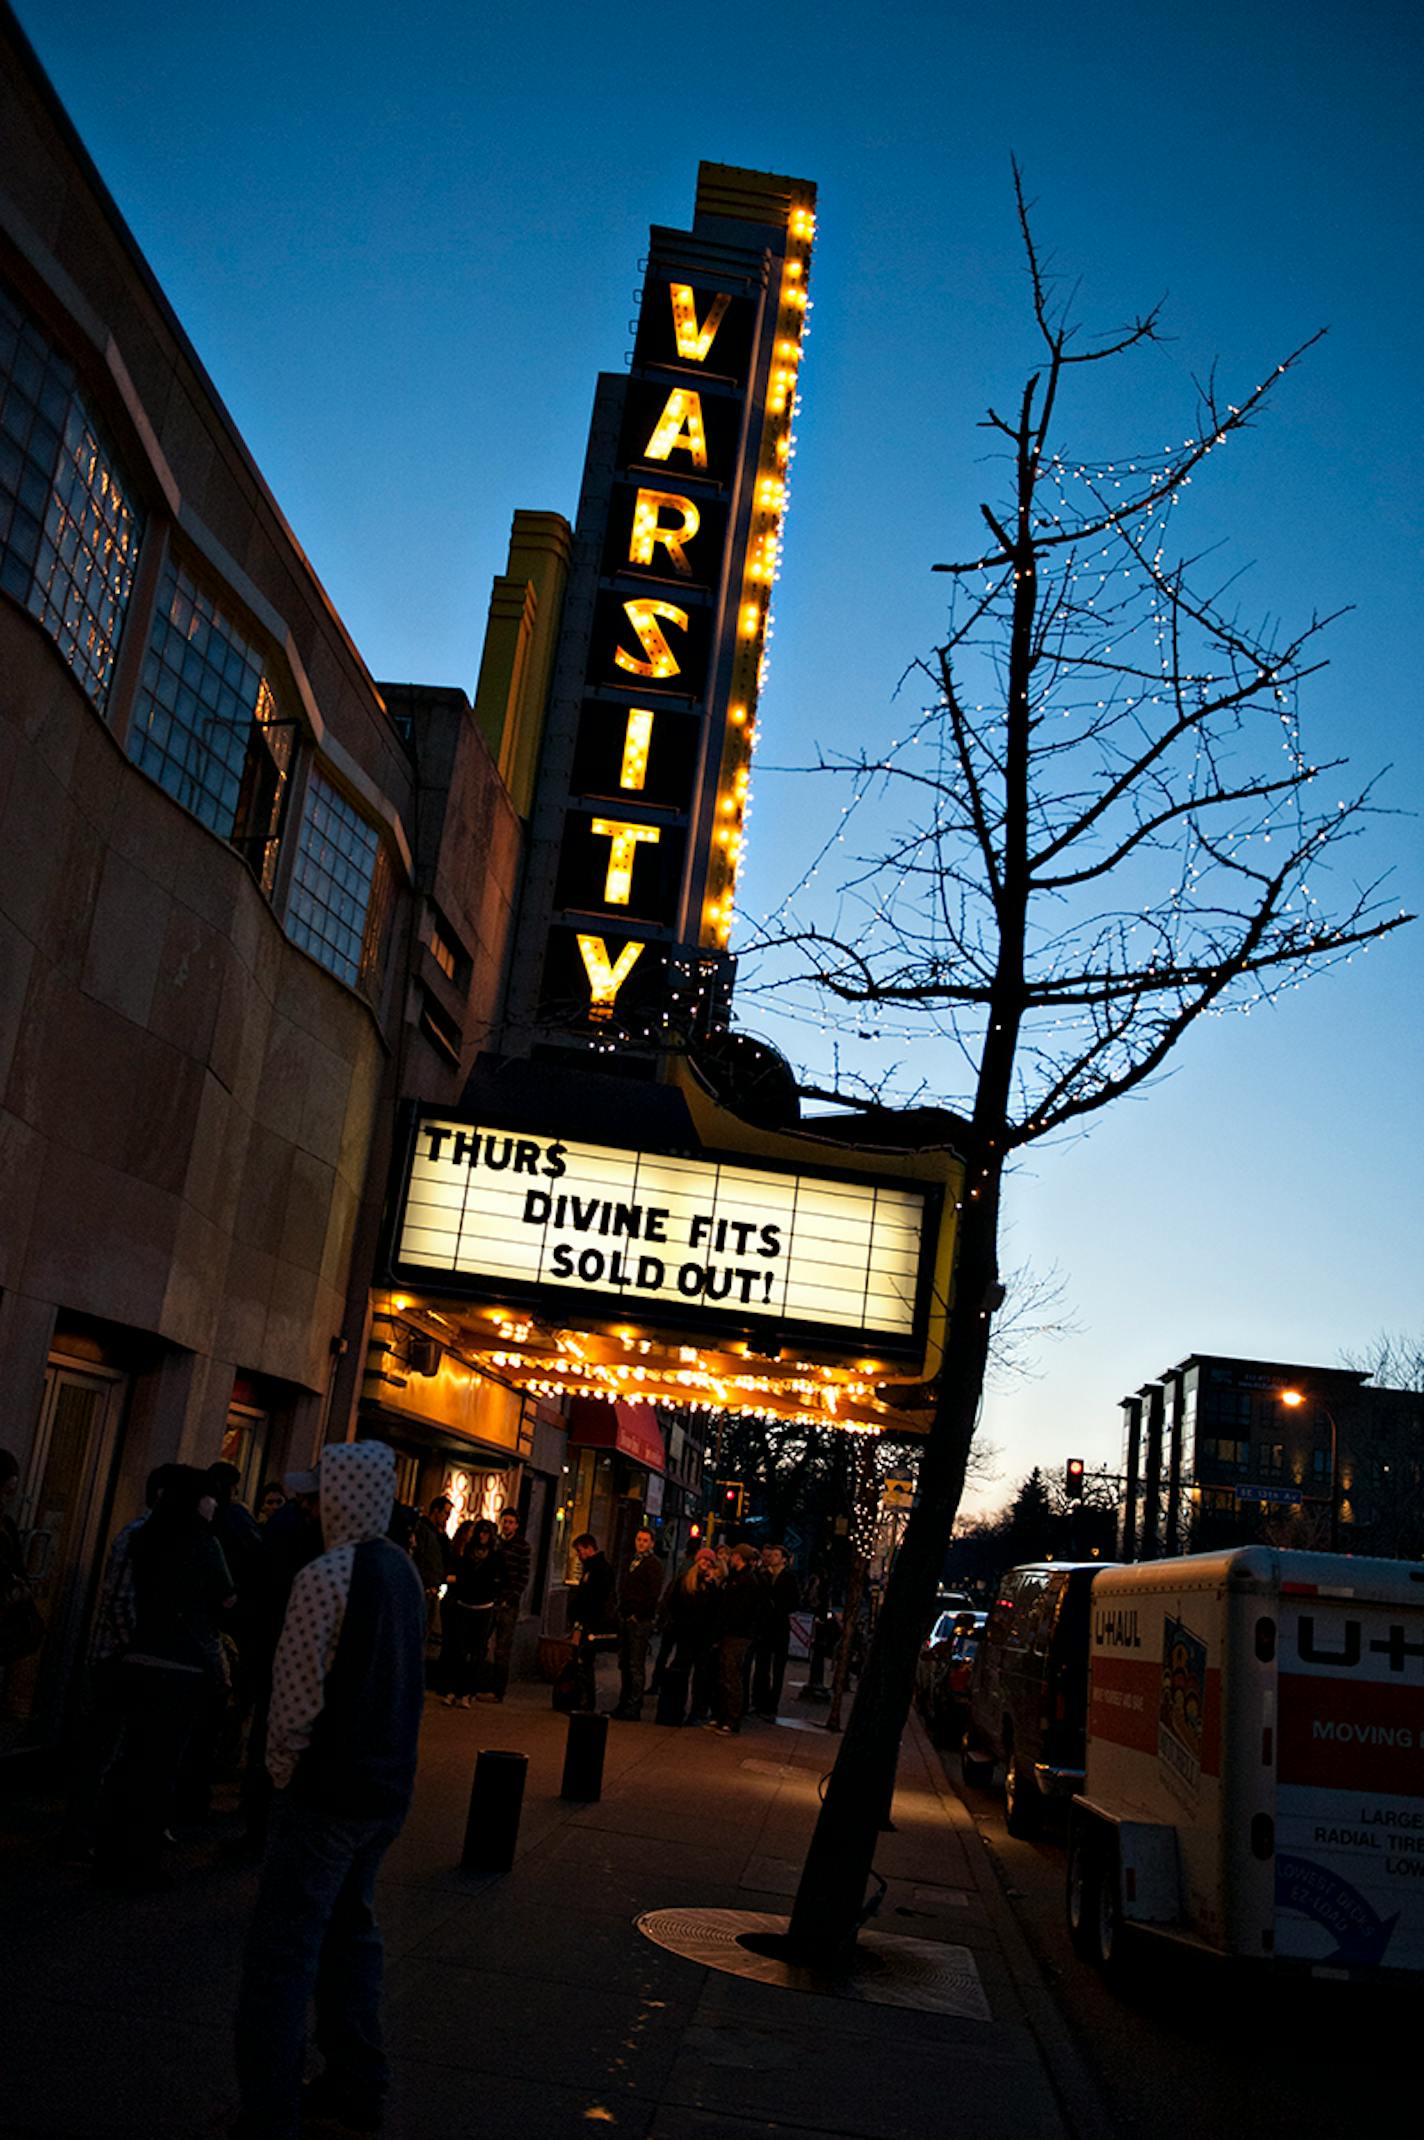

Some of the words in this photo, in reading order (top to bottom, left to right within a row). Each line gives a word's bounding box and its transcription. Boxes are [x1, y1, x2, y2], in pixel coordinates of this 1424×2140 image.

[576, 282, 732, 1019] VARSITY
[424, 1125, 568, 1178] THURS
[522, 1189, 669, 1242] DIVINE
[689, 1214, 782, 1258] FITS
[550, 1244, 665, 1290] SOLD
[677, 1262, 775, 1304] OUT!
[440, 1471, 512, 1493] ACTION
[1312, 1720, 1413, 1749] MOVING
[1315, 1827, 1382, 1849] RADIAL
[1277, 1861, 1337, 1895] LOWEST
